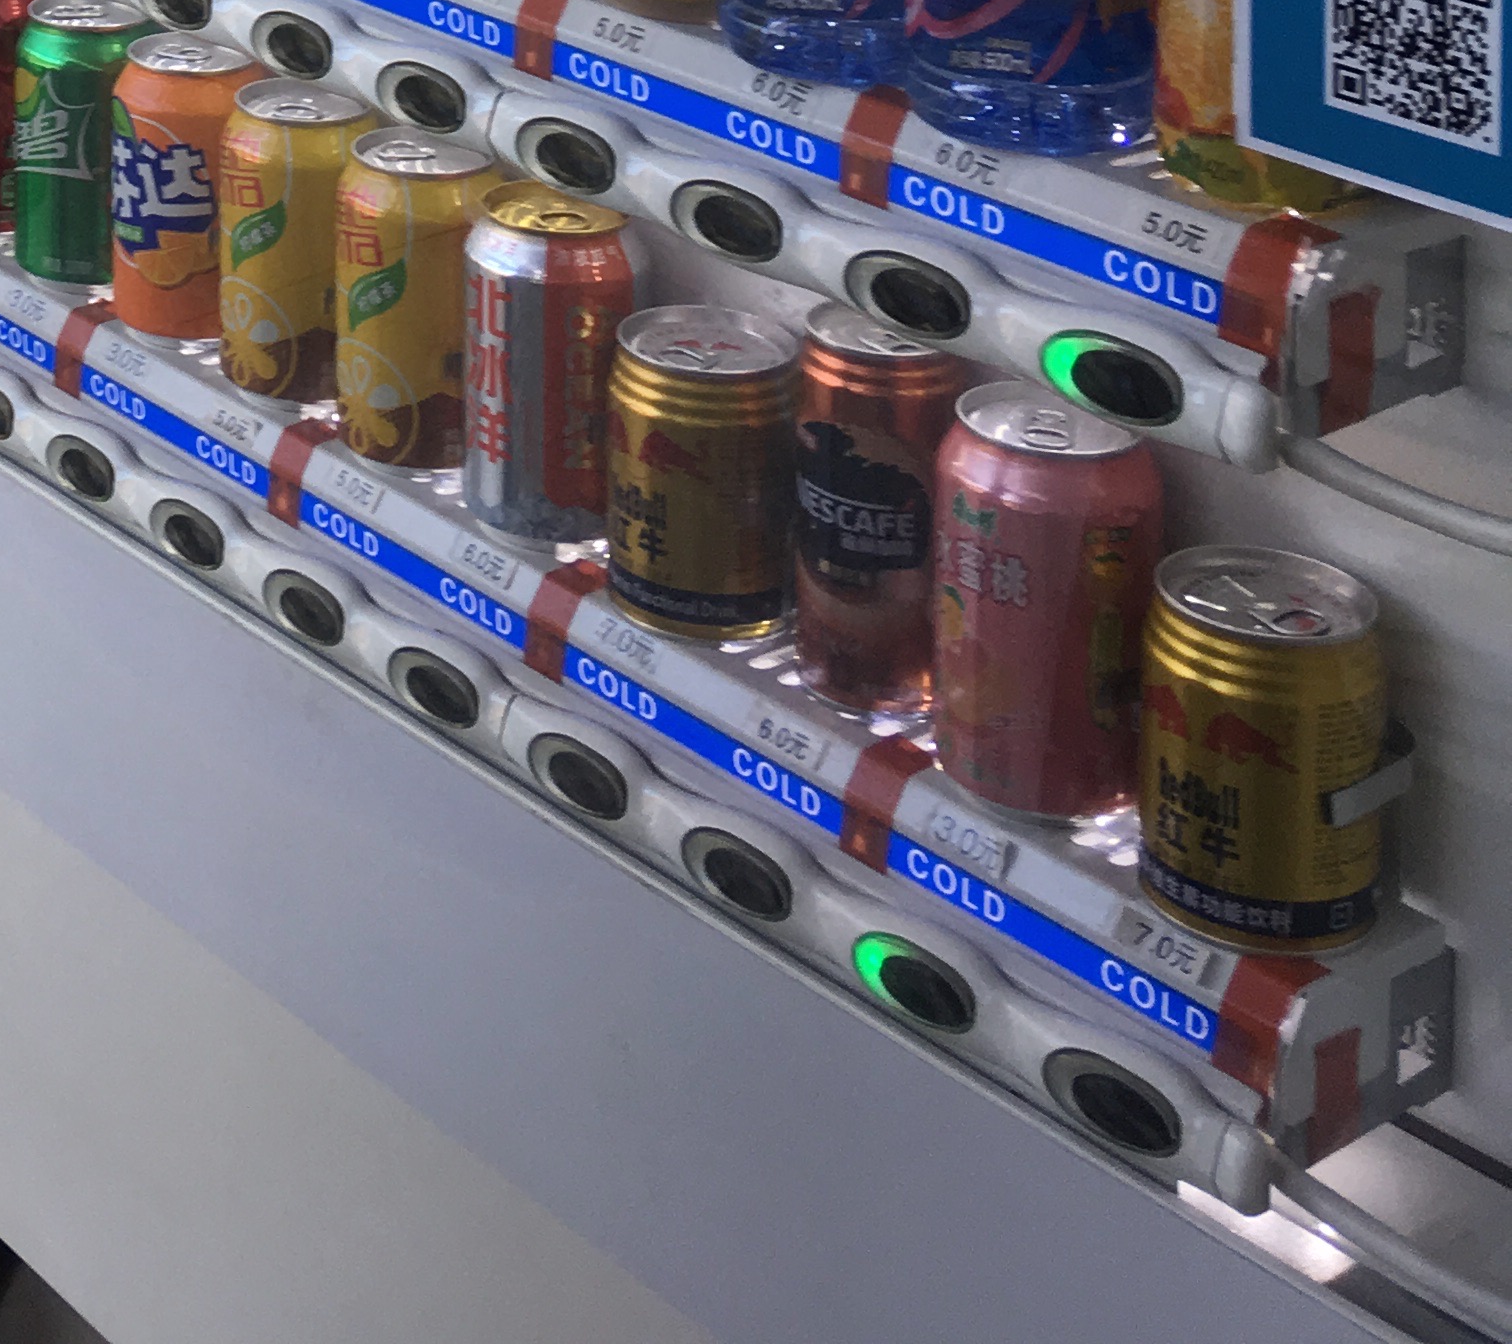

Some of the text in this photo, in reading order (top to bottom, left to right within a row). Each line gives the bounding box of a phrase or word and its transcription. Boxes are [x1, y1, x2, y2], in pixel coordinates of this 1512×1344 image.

[427, 1, 501, 46] COLD
[593, 16, 647, 53] 5.0元
[568, 52, 650, 102] COLD
[752, 72, 812, 116] 6.0元
[726, 110, 817, 166] COLD
[934, 141, 1000, 187] 6.0元
[903, 177, 1006, 237] COLD
[1141, 211, 1208, 256] 5.0元
[1102, 249, 1218, 316] COLD
[466, 274, 514, 463] 北冰洋
[89, 374, 147, 422] COLD
[195, 435, 257, 486] COLD
[312, 503, 379, 558] COLD
[440, 577, 513, 636] COLD
[577, 658, 658, 721] COLD
[731, 749, 822, 818] COLD
[933, 812, 1006, 870] 3.0元
[906, 849, 1007, 924] COLD
[1133, 922, 1200, 976] 7.0元
[1099, 958, 1211, 1042] COLD
